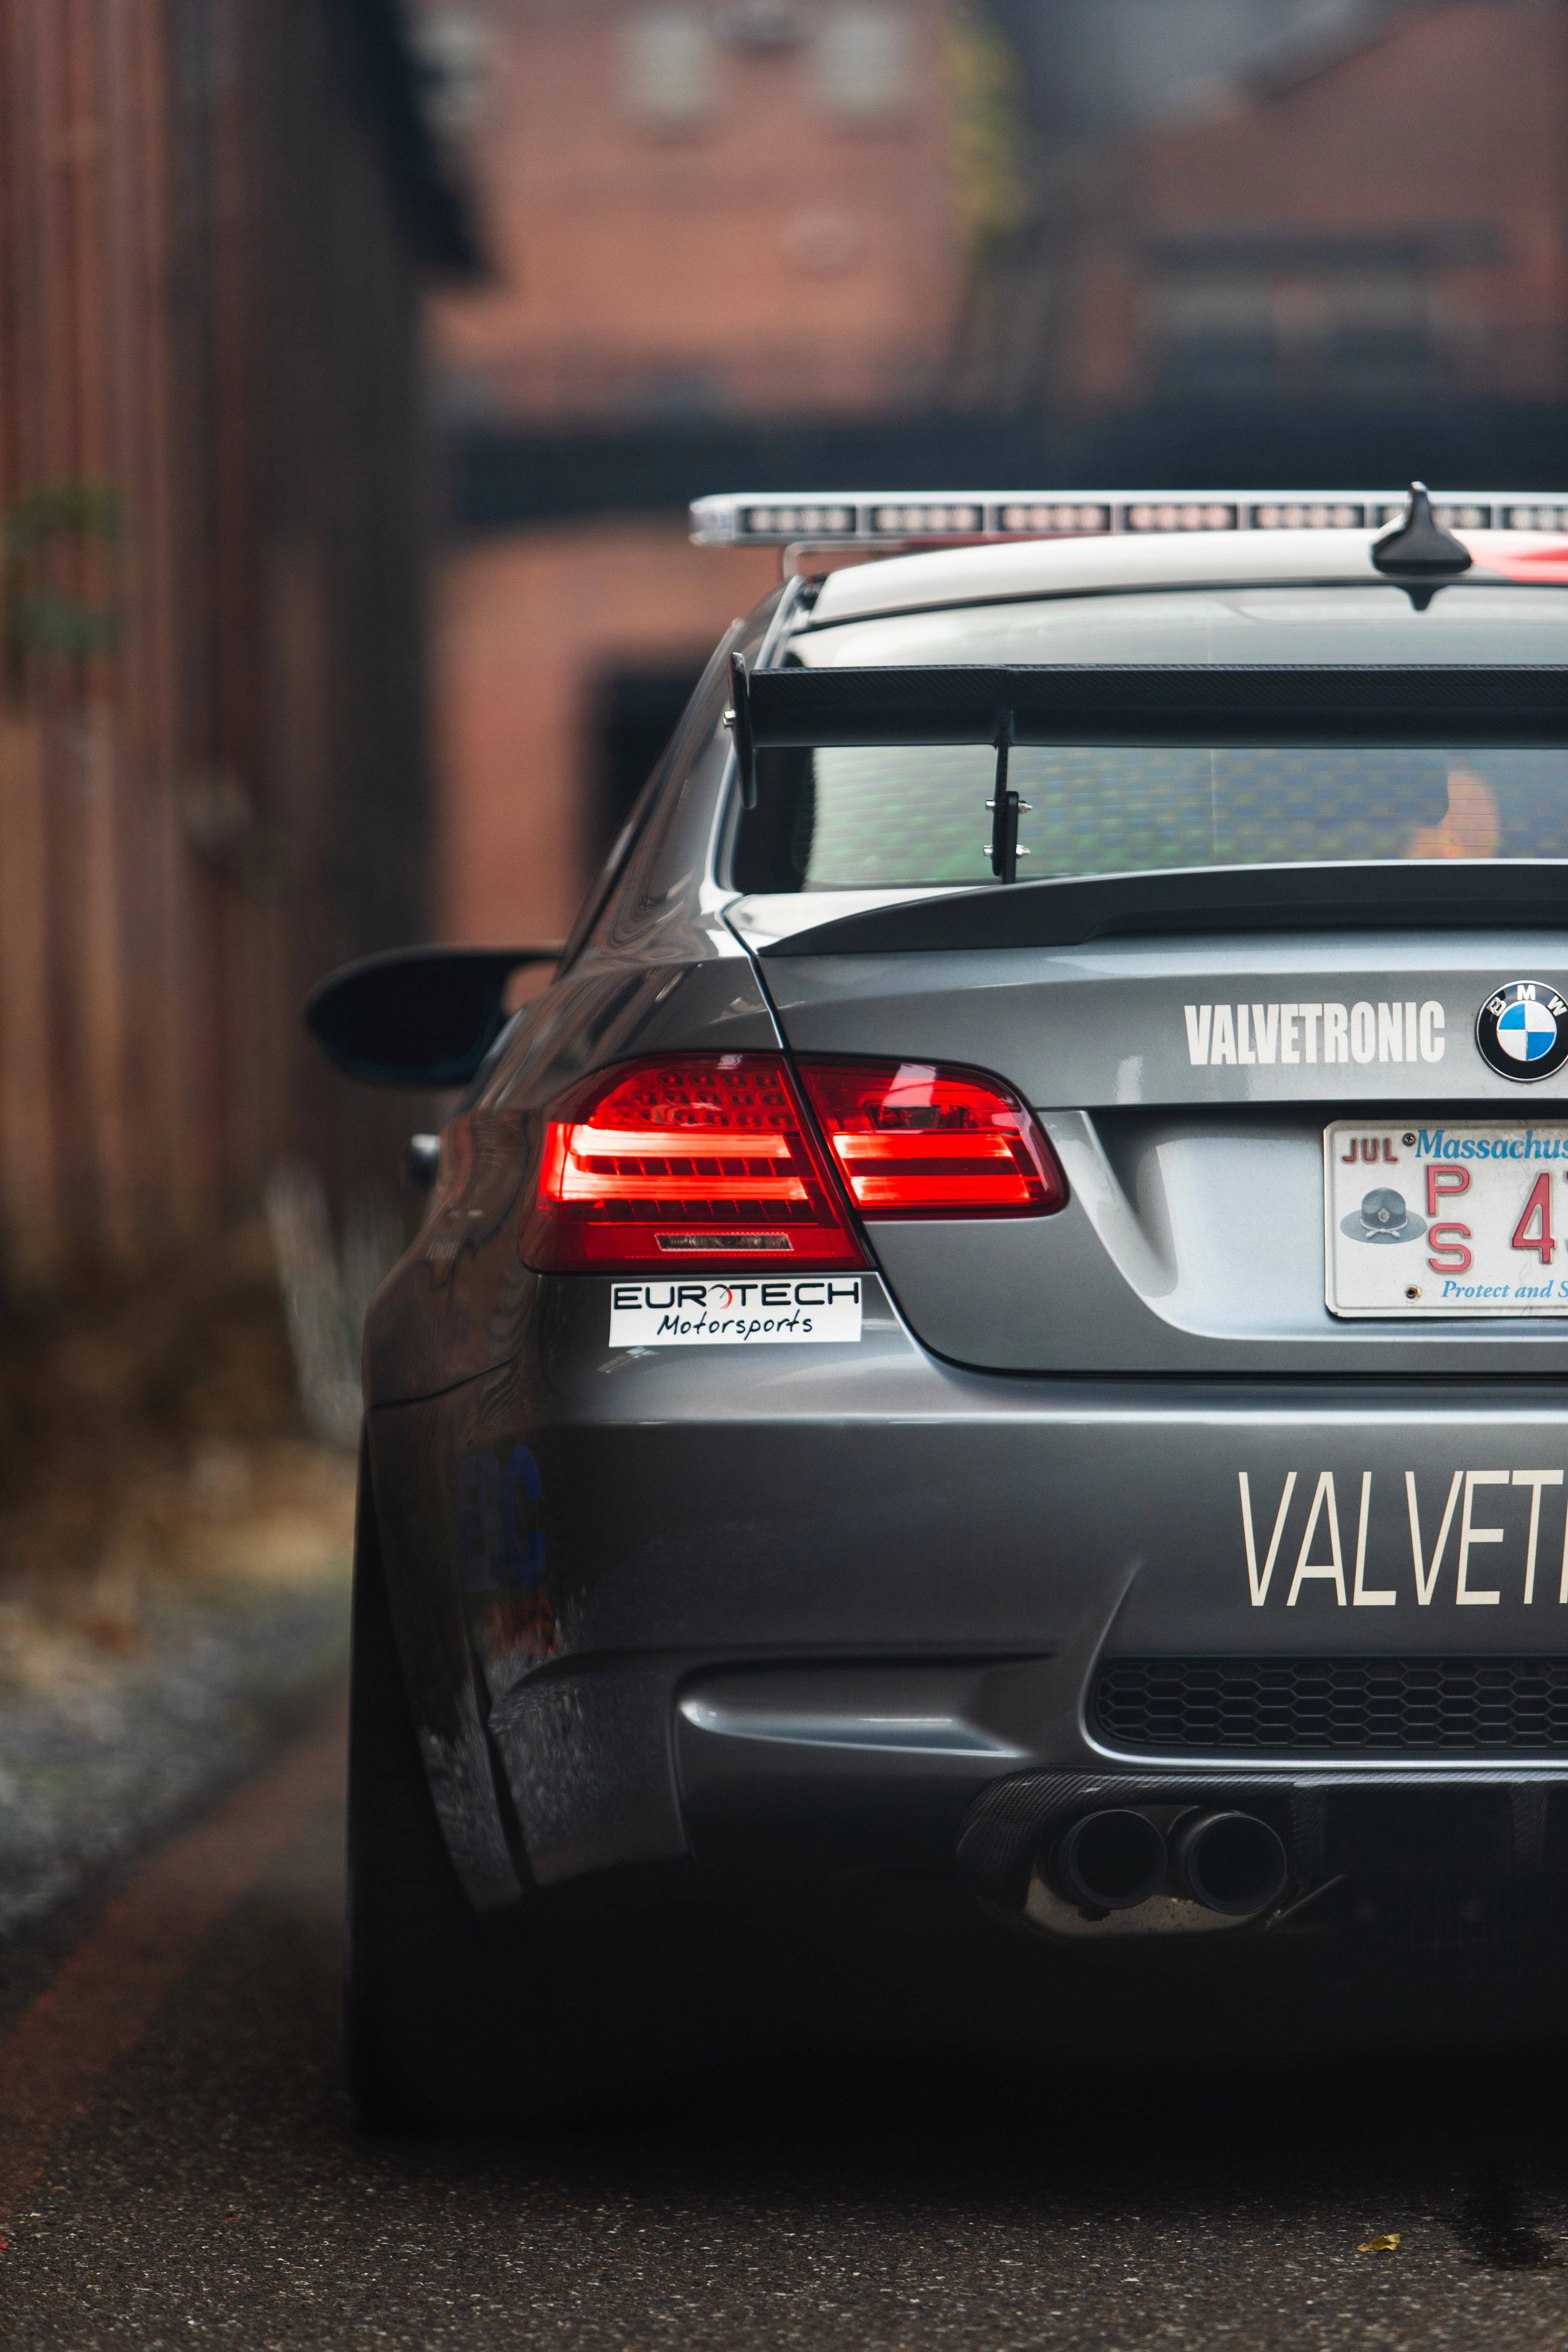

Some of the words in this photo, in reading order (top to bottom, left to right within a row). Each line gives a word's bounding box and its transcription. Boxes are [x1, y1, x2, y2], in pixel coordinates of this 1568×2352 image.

[1486, 984, 1568, 1017] BMW
[1184, 1000, 1446, 1065] VALVETRONIC
[1343, 1139, 1398, 1162] JUL
[1512, 1172, 1568, 1263] 4
[613, 1281, 859, 1310] EUROTECH
[1441, 1281, 1510, 1298] Protect
[1514, 1280, 1554, 1298] and
[657, 1309, 813, 1341] Motorsports
[1238, 1470, 1568, 1606] VALVET
